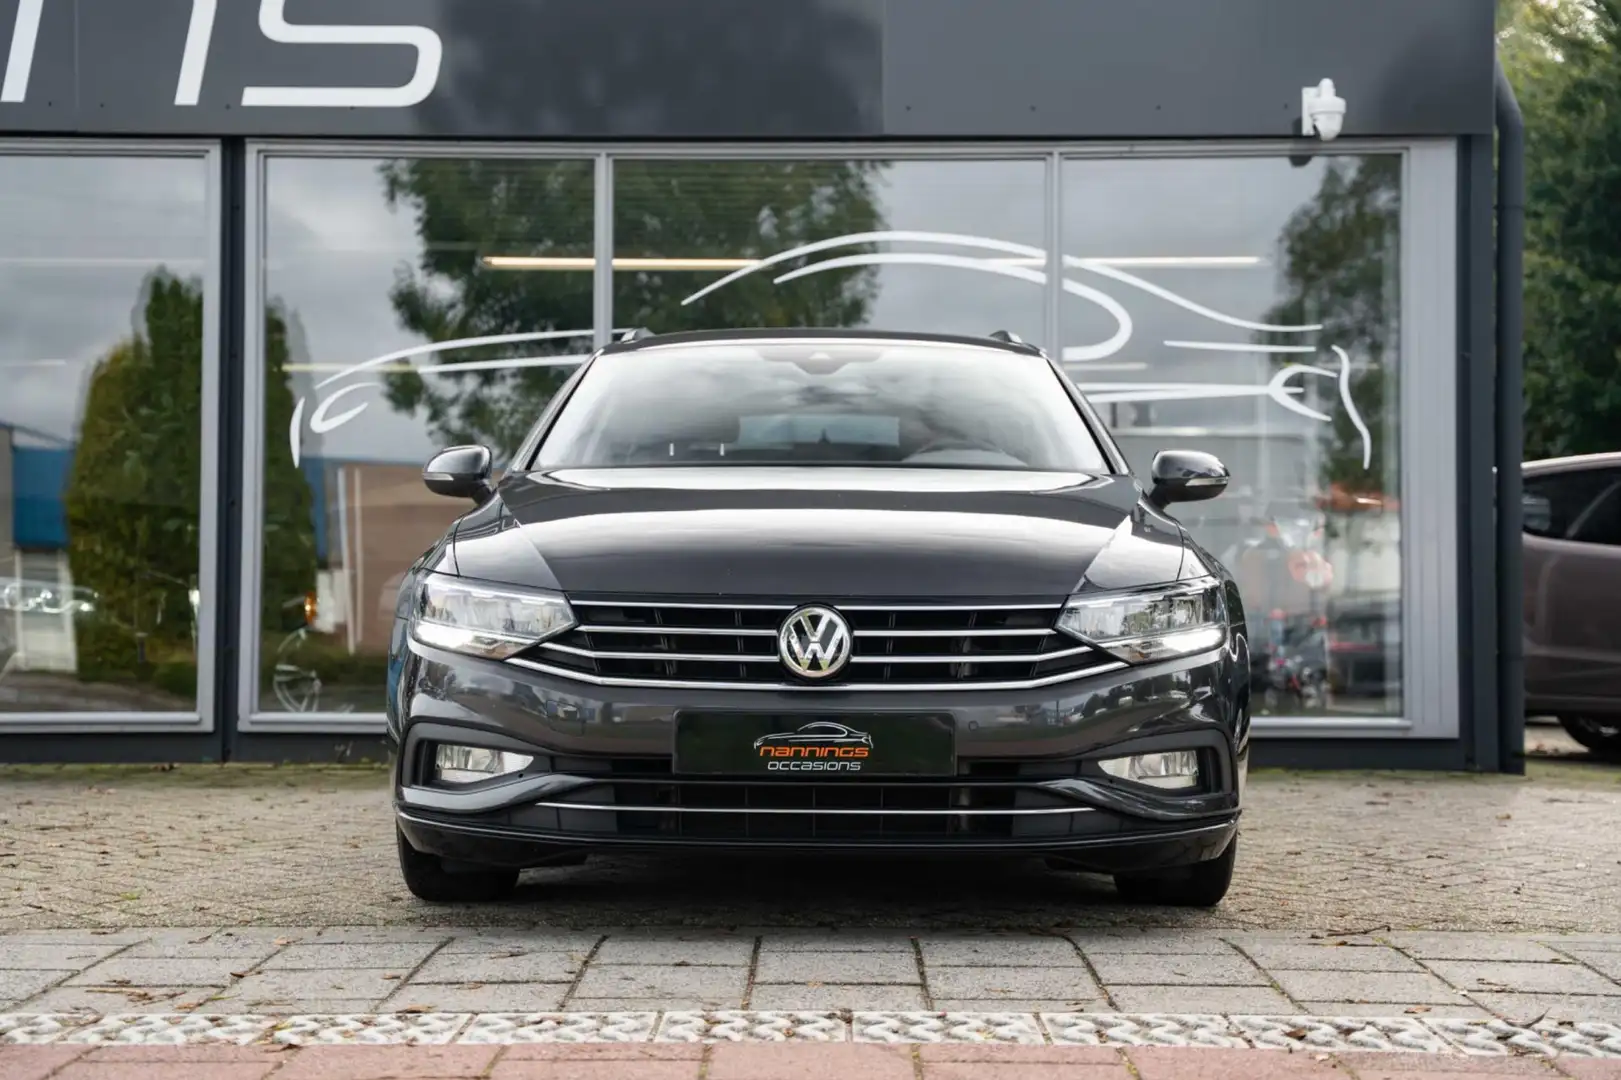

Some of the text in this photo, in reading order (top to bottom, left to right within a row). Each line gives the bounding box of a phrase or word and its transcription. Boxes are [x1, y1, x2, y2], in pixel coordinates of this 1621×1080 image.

[784, 609, 846, 673] VW
[759, 746, 870, 758] nannings
[767, 761, 862, 772] occasions
